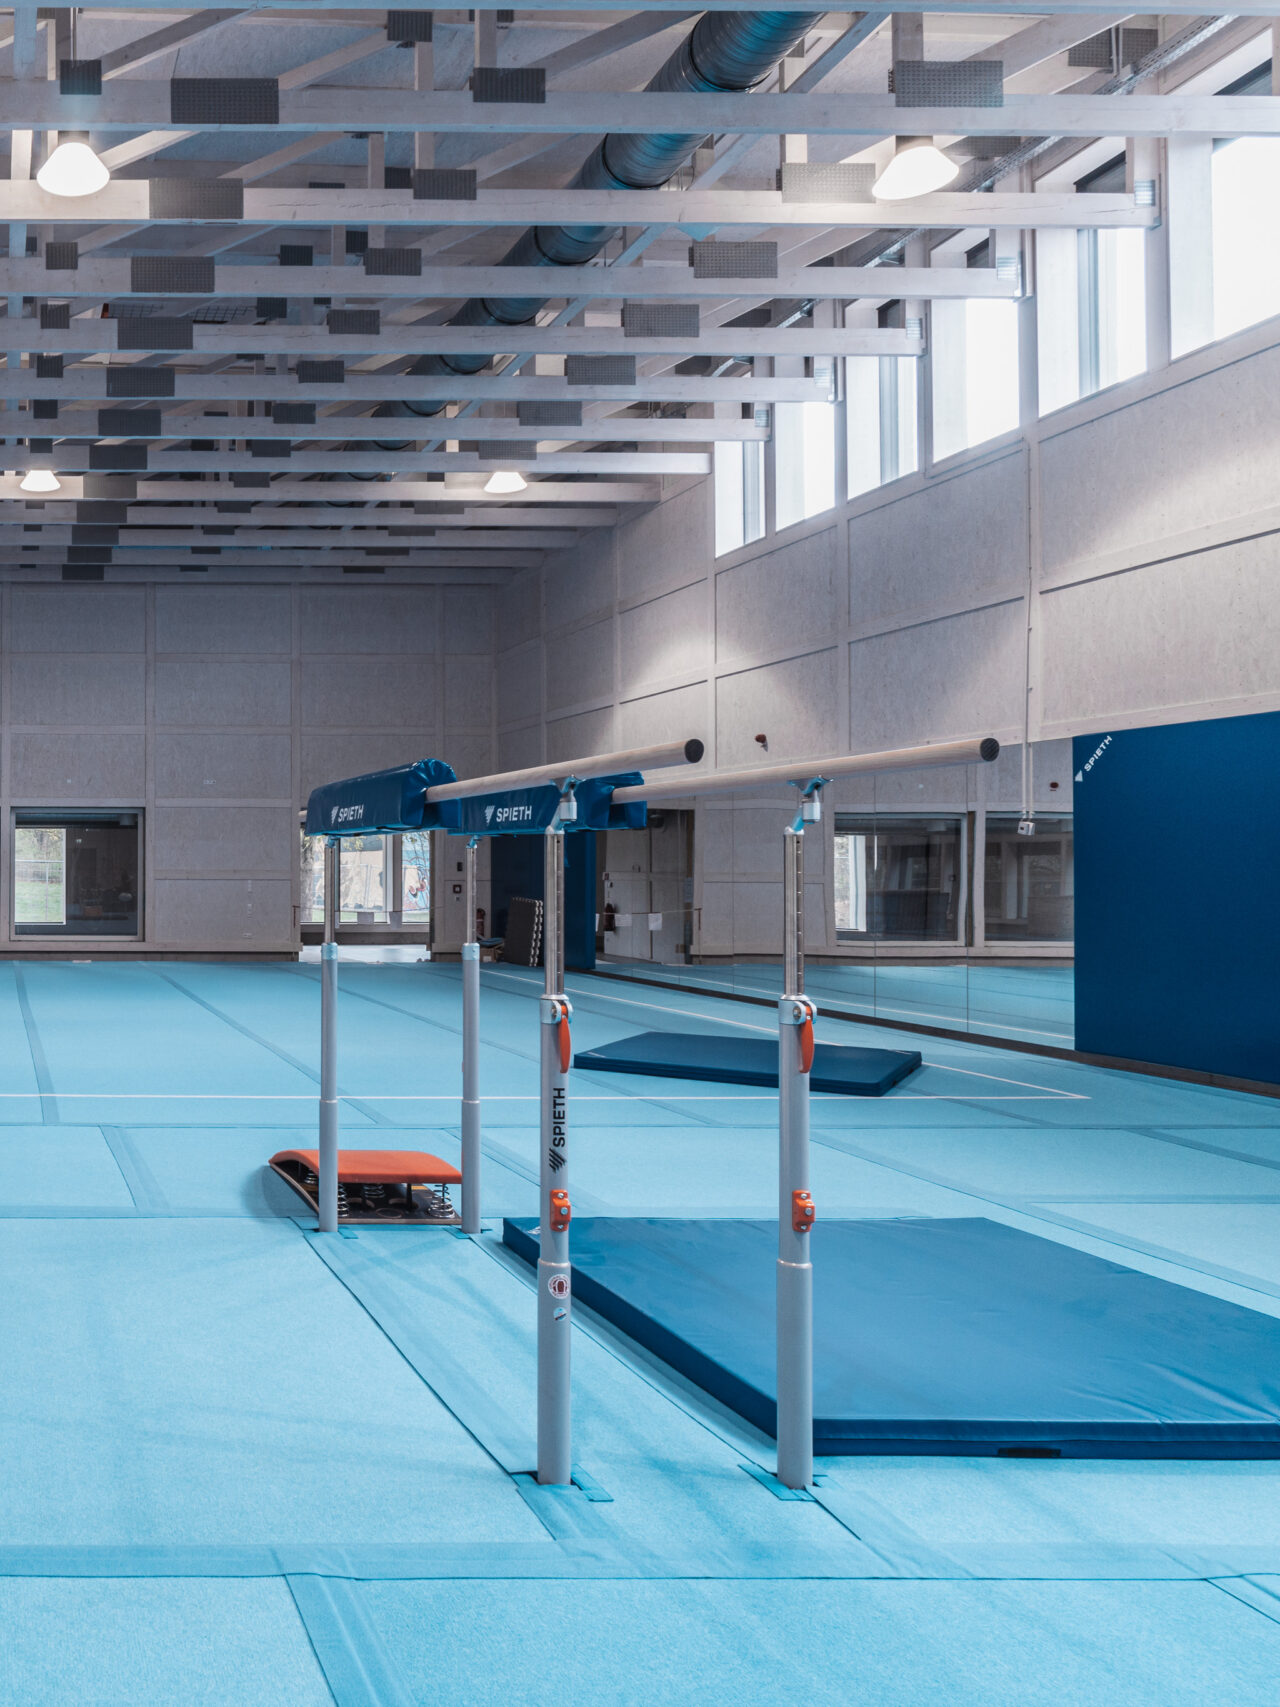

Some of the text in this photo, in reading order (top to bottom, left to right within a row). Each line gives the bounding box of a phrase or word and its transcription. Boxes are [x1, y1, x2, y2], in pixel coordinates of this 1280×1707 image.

[1084, 735, 1112, 772] SPIETH
[337, 804, 365, 823] SPIETH
[496, 805, 532, 823] SPIETH
[552, 1087, 566, 1148] SPIETH
